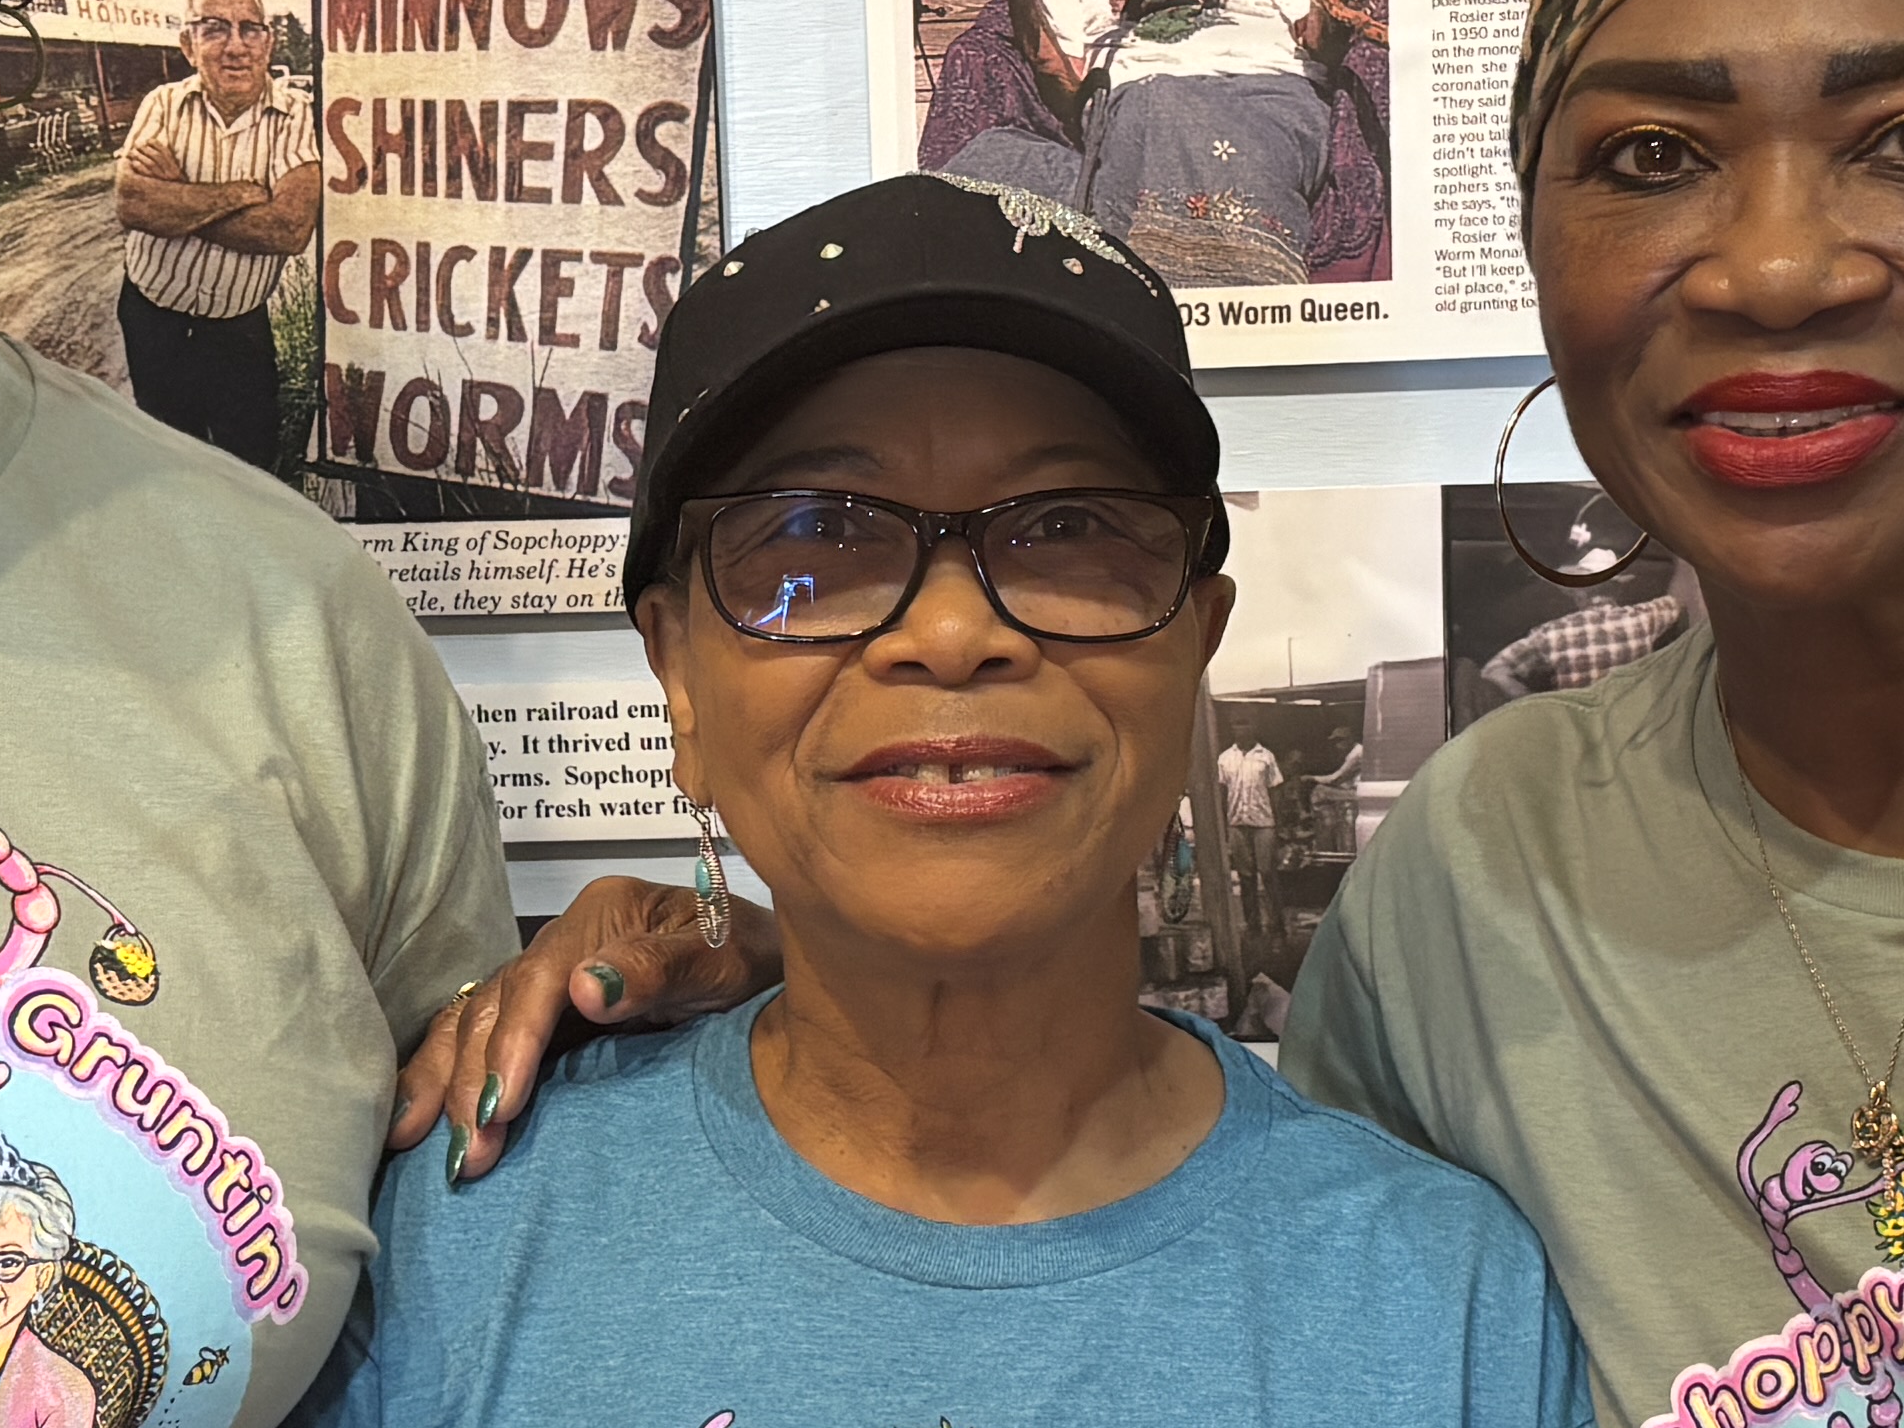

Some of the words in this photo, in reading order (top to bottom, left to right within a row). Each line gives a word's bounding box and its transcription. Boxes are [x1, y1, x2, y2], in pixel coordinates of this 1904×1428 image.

[326, 96, 693, 208] SHINERS
[324, 239, 684, 352] CRICKETS
[1218, 302, 1293, 327] Worm
[1300, 299, 1390, 325] Queen.
[325, 361, 652, 500] WORMS
[400, 532, 460, 557] King
[466, 531, 492, 555] of
[493, 529, 628, 556] Sopchoppy:
[388, 559, 462, 583] retails
[468, 558, 560, 584] himself.
[566, 556, 617, 580] He's
[454, 590, 502, 615] they
[510, 591, 557, 614] stay
[566, 594, 595, 608] on
[473, 704, 518, 724] hen
[526, 700, 619, 722] railroad
[522, 735, 540, 755] It
[547, 731, 631, 755] thrived
[535, 798, 592, 819] fresh
[599, 798, 667, 817] water
